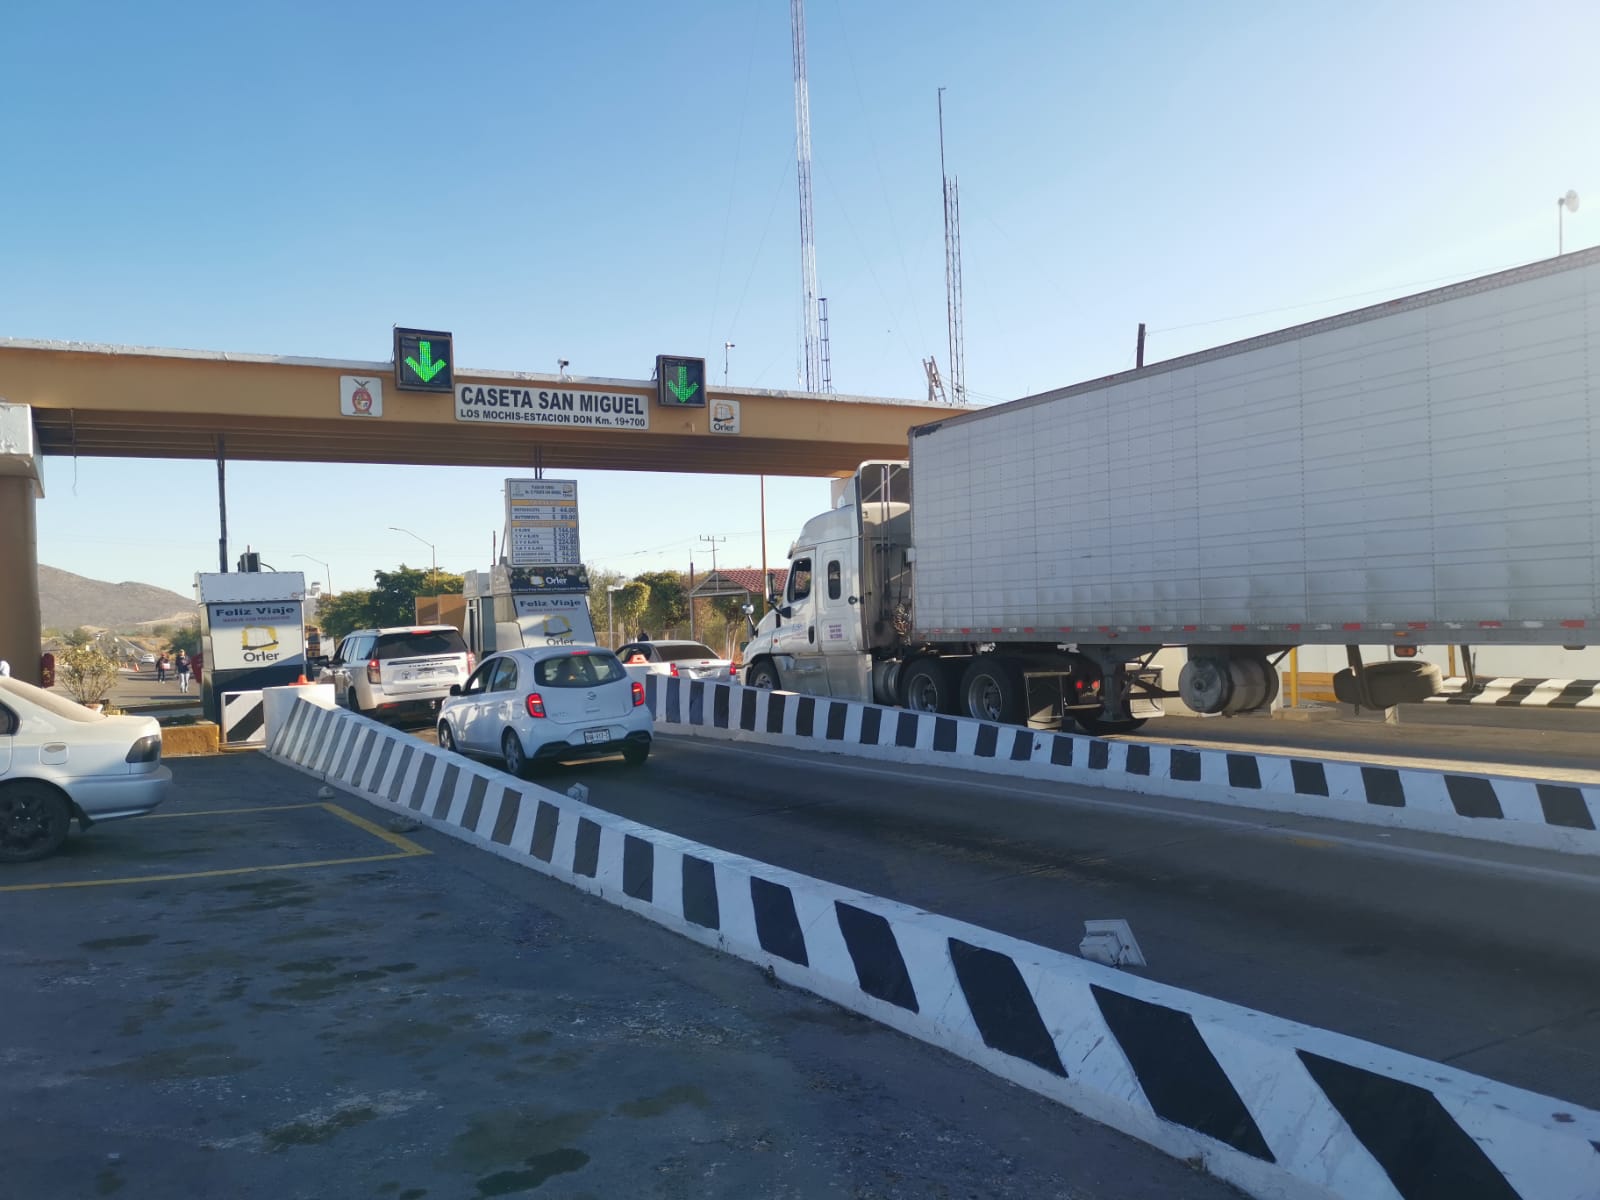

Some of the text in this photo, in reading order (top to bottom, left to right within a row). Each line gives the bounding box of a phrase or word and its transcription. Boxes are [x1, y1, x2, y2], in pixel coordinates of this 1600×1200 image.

[461, 387, 644, 415] CASETA SAN MIGUEL
[460, 409, 645, 427] LOS MOCHIS-ESTACION DON Km. 19+700
[519, 599, 581, 608] Feliz Viaje
[216, 606, 295, 616] Feliz Viaje
